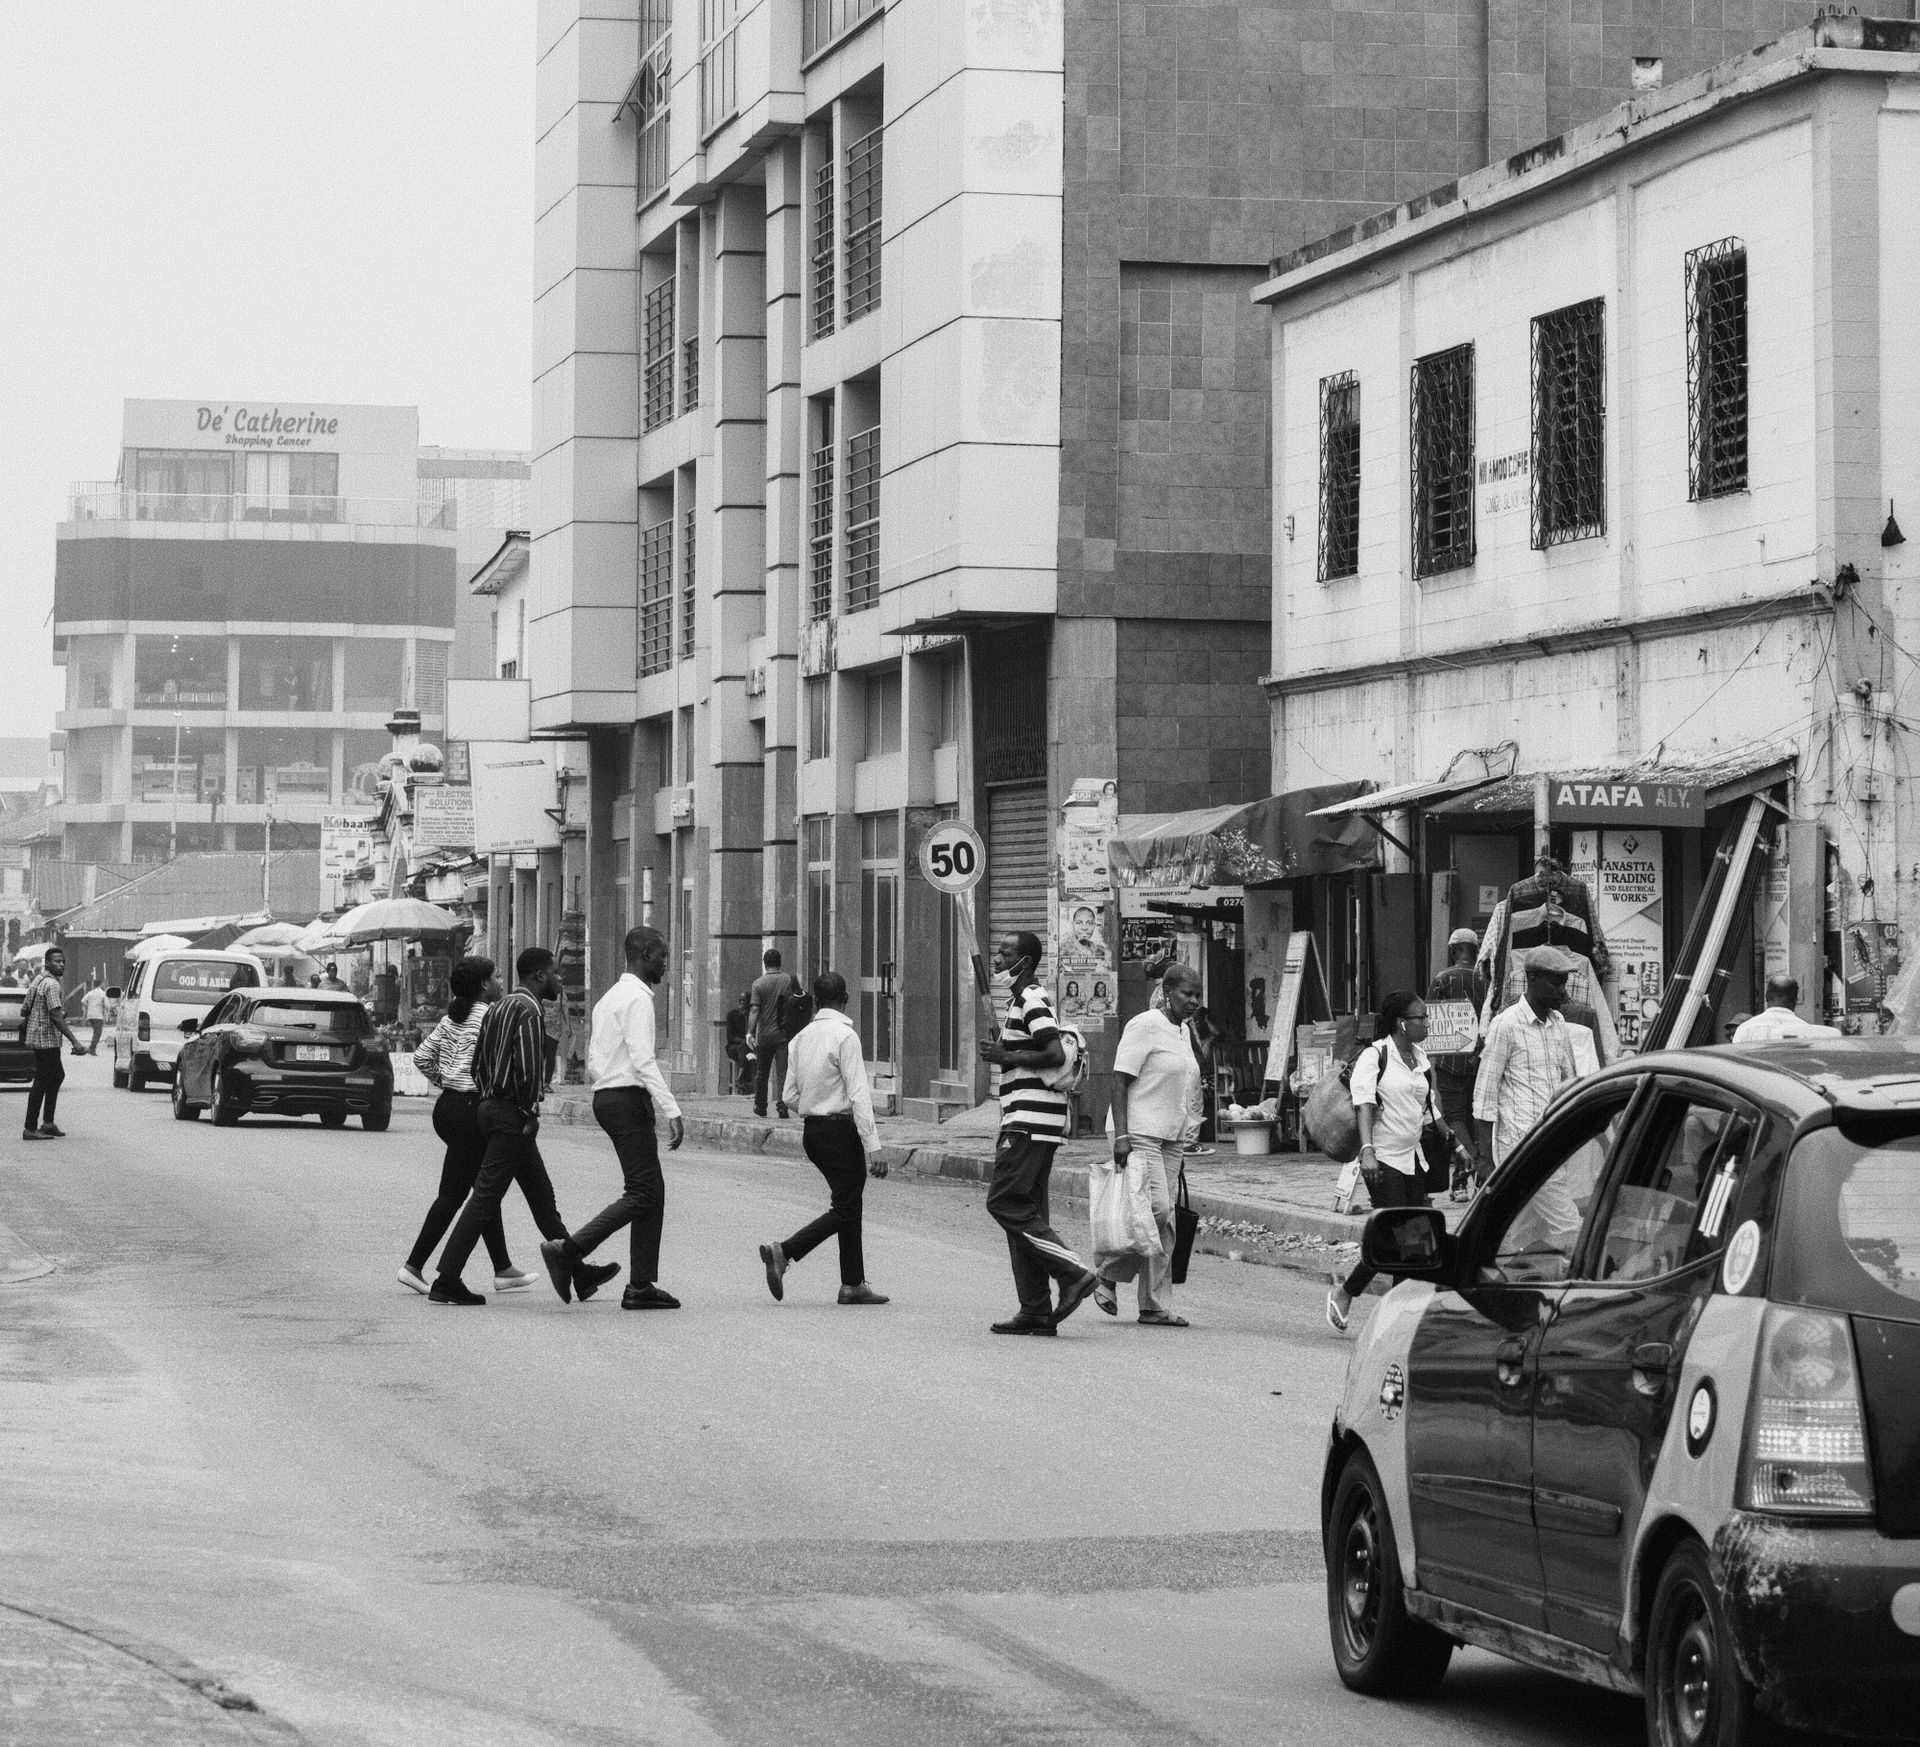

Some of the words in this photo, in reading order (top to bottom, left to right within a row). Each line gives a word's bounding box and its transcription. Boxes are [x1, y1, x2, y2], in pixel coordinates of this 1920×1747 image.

[234, 407, 339, 434] Catherine
[225, 433, 273, 447] Shopping
[277, 435, 311, 446] Center
[1556, 784, 1644, 807] ATAFA
[931, 840, 975, 877] 50
[1604, 861, 1656, 871] ANASTTA
[1603, 873, 1656, 884] TRADING
[1612, 893, 1648, 903] WORKS
